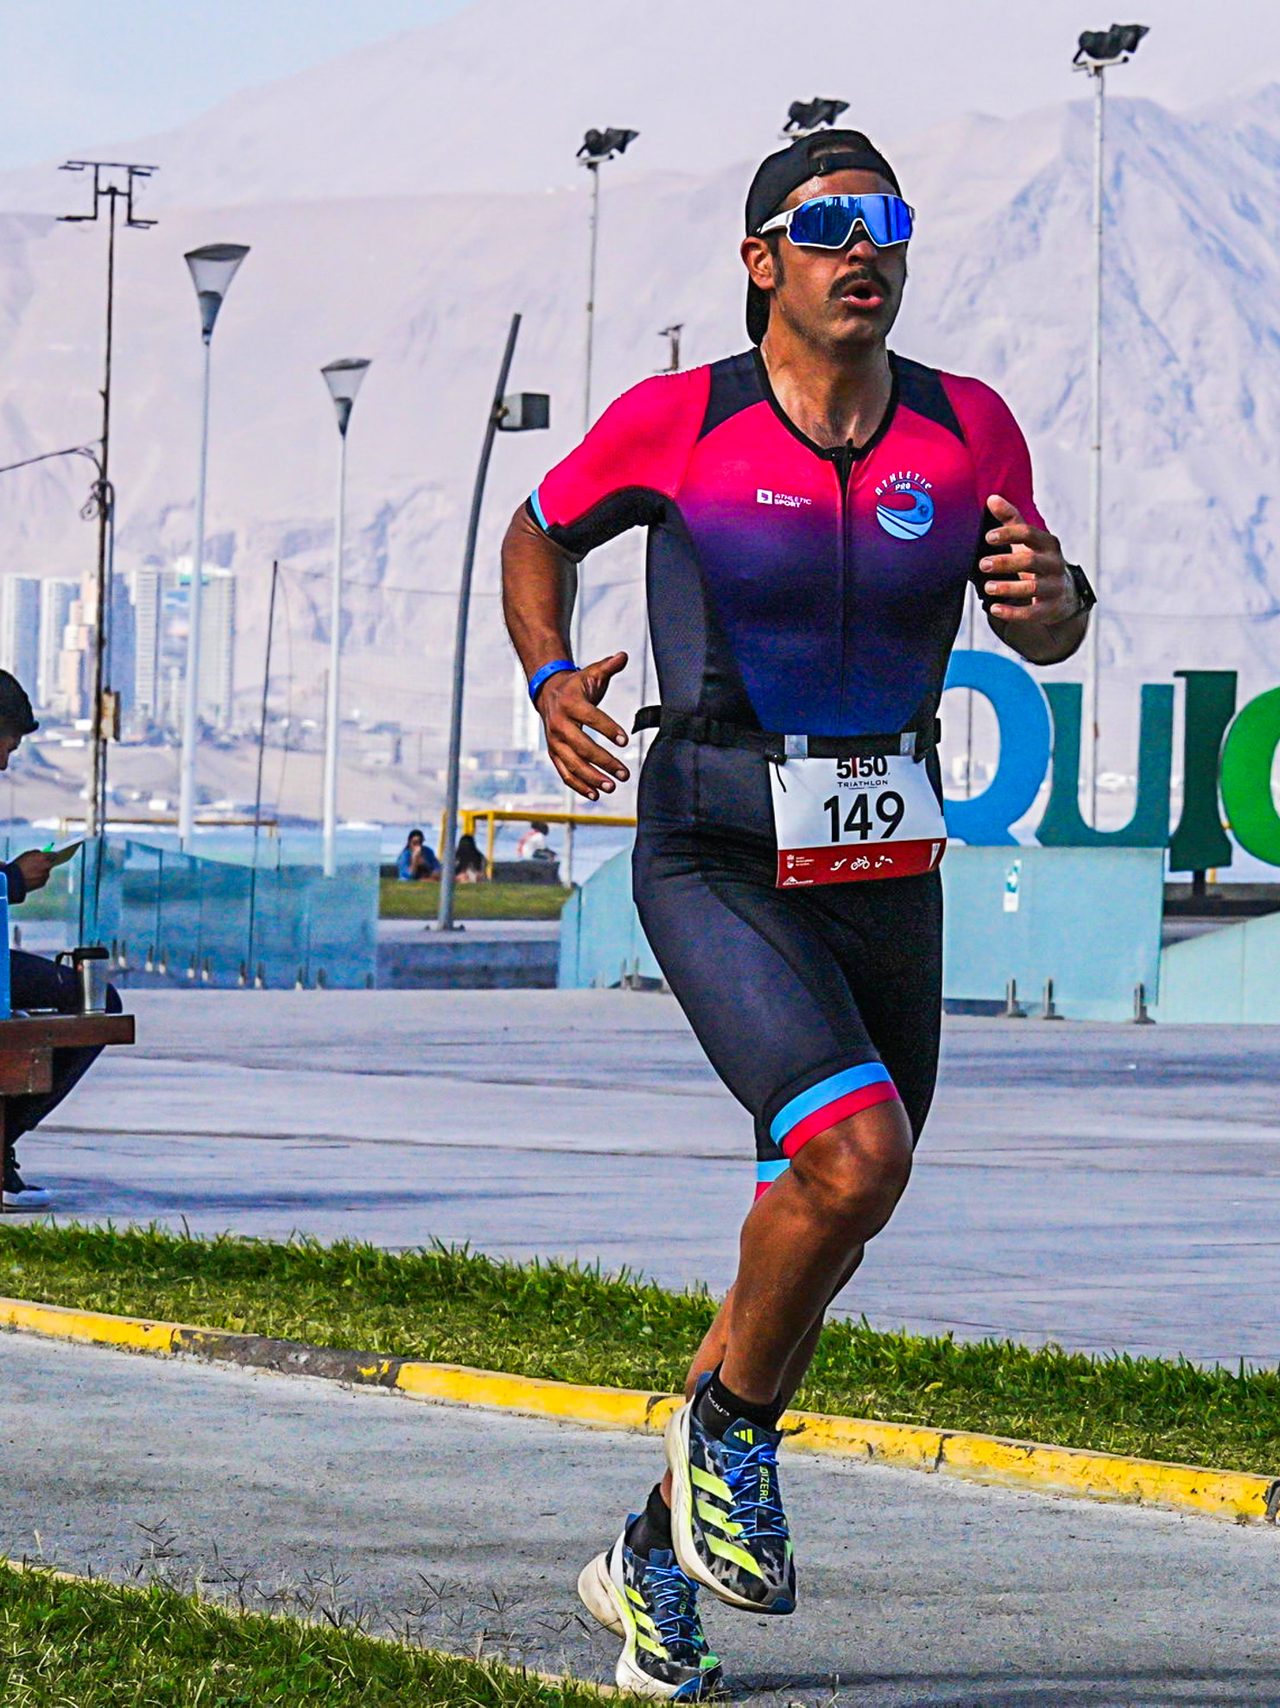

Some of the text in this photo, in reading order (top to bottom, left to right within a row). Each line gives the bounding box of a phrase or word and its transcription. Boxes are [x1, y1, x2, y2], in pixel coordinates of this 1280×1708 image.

[875, 471, 932, 495] ATHLETIC
[895, 482, 911, 490] PRO
[774, 493, 812, 505] ATHLETIC
[774, 498, 801, 508] SPORT
[837, 780, 888, 788] TRIATHLON
[824, 791, 905, 843] 149
[759, 1464, 770, 1503] DIZERO
